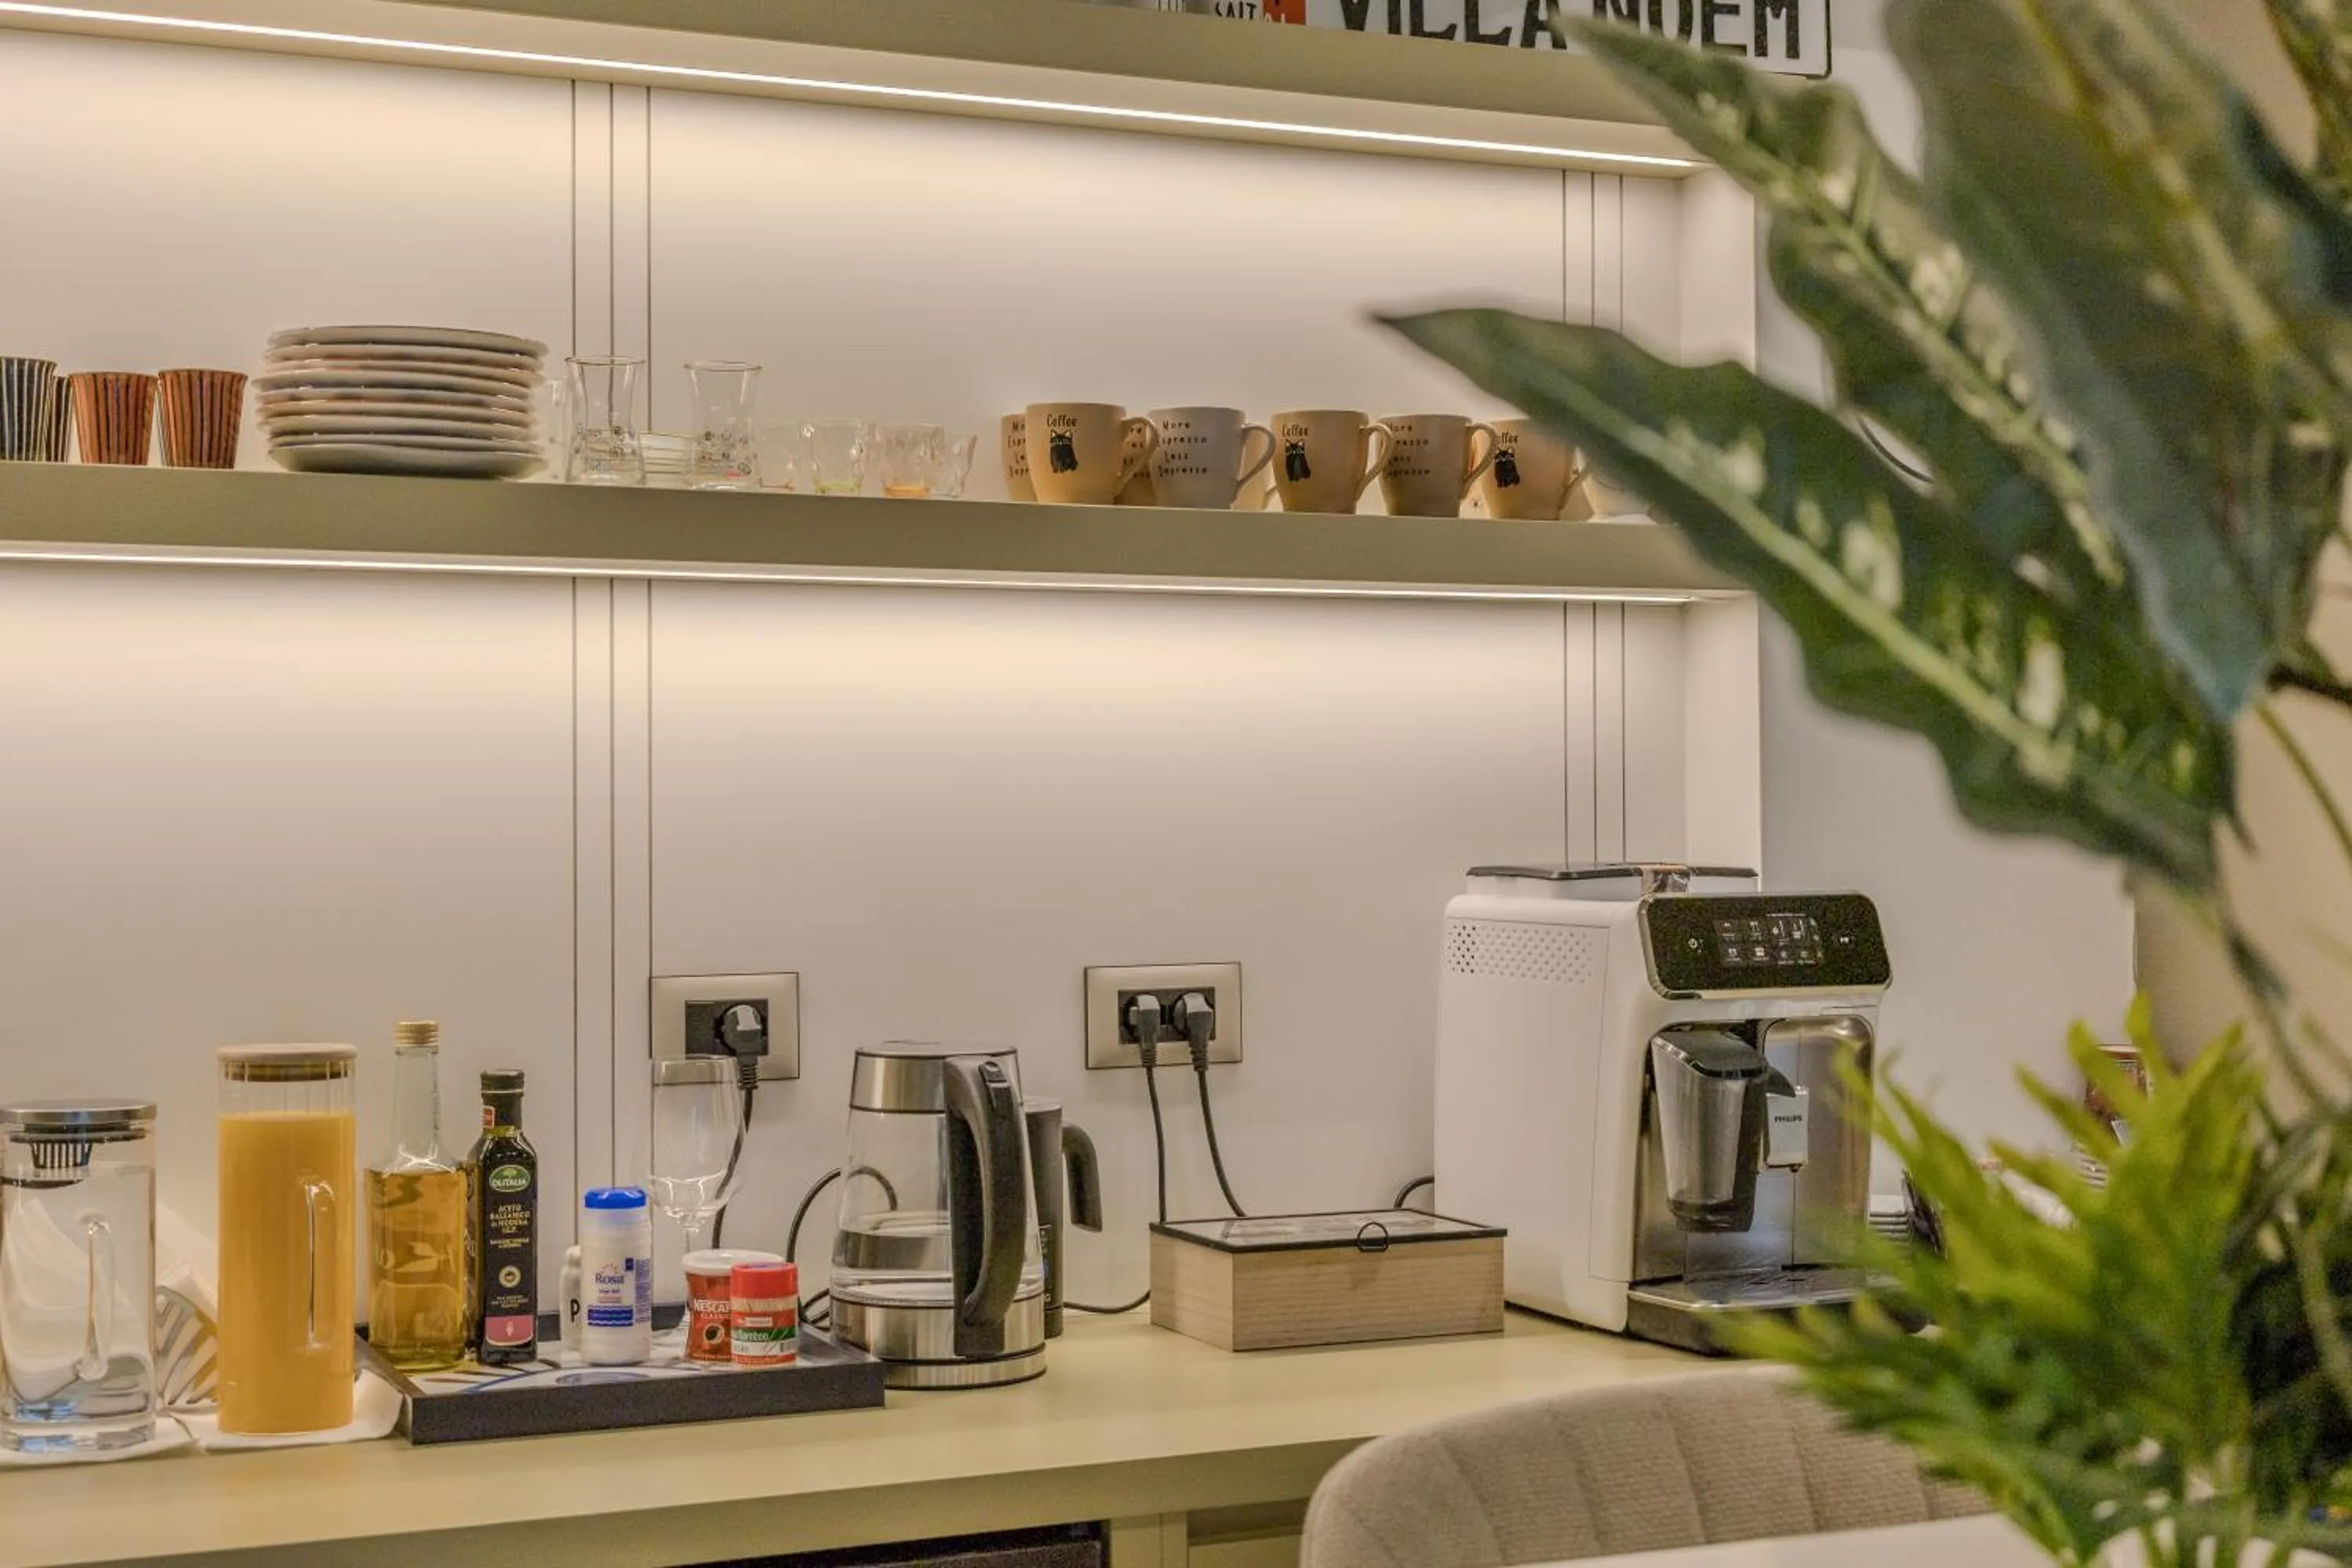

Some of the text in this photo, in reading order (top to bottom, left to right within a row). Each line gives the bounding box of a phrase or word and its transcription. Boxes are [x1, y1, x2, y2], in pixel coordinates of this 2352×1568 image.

[1593, 0, 1800, 59] OEM
[1047, 414, 1078, 427] Coffee
[492, 1178, 526, 1187] OLITALIA
[694, 1298, 731, 1312] NESCAF
